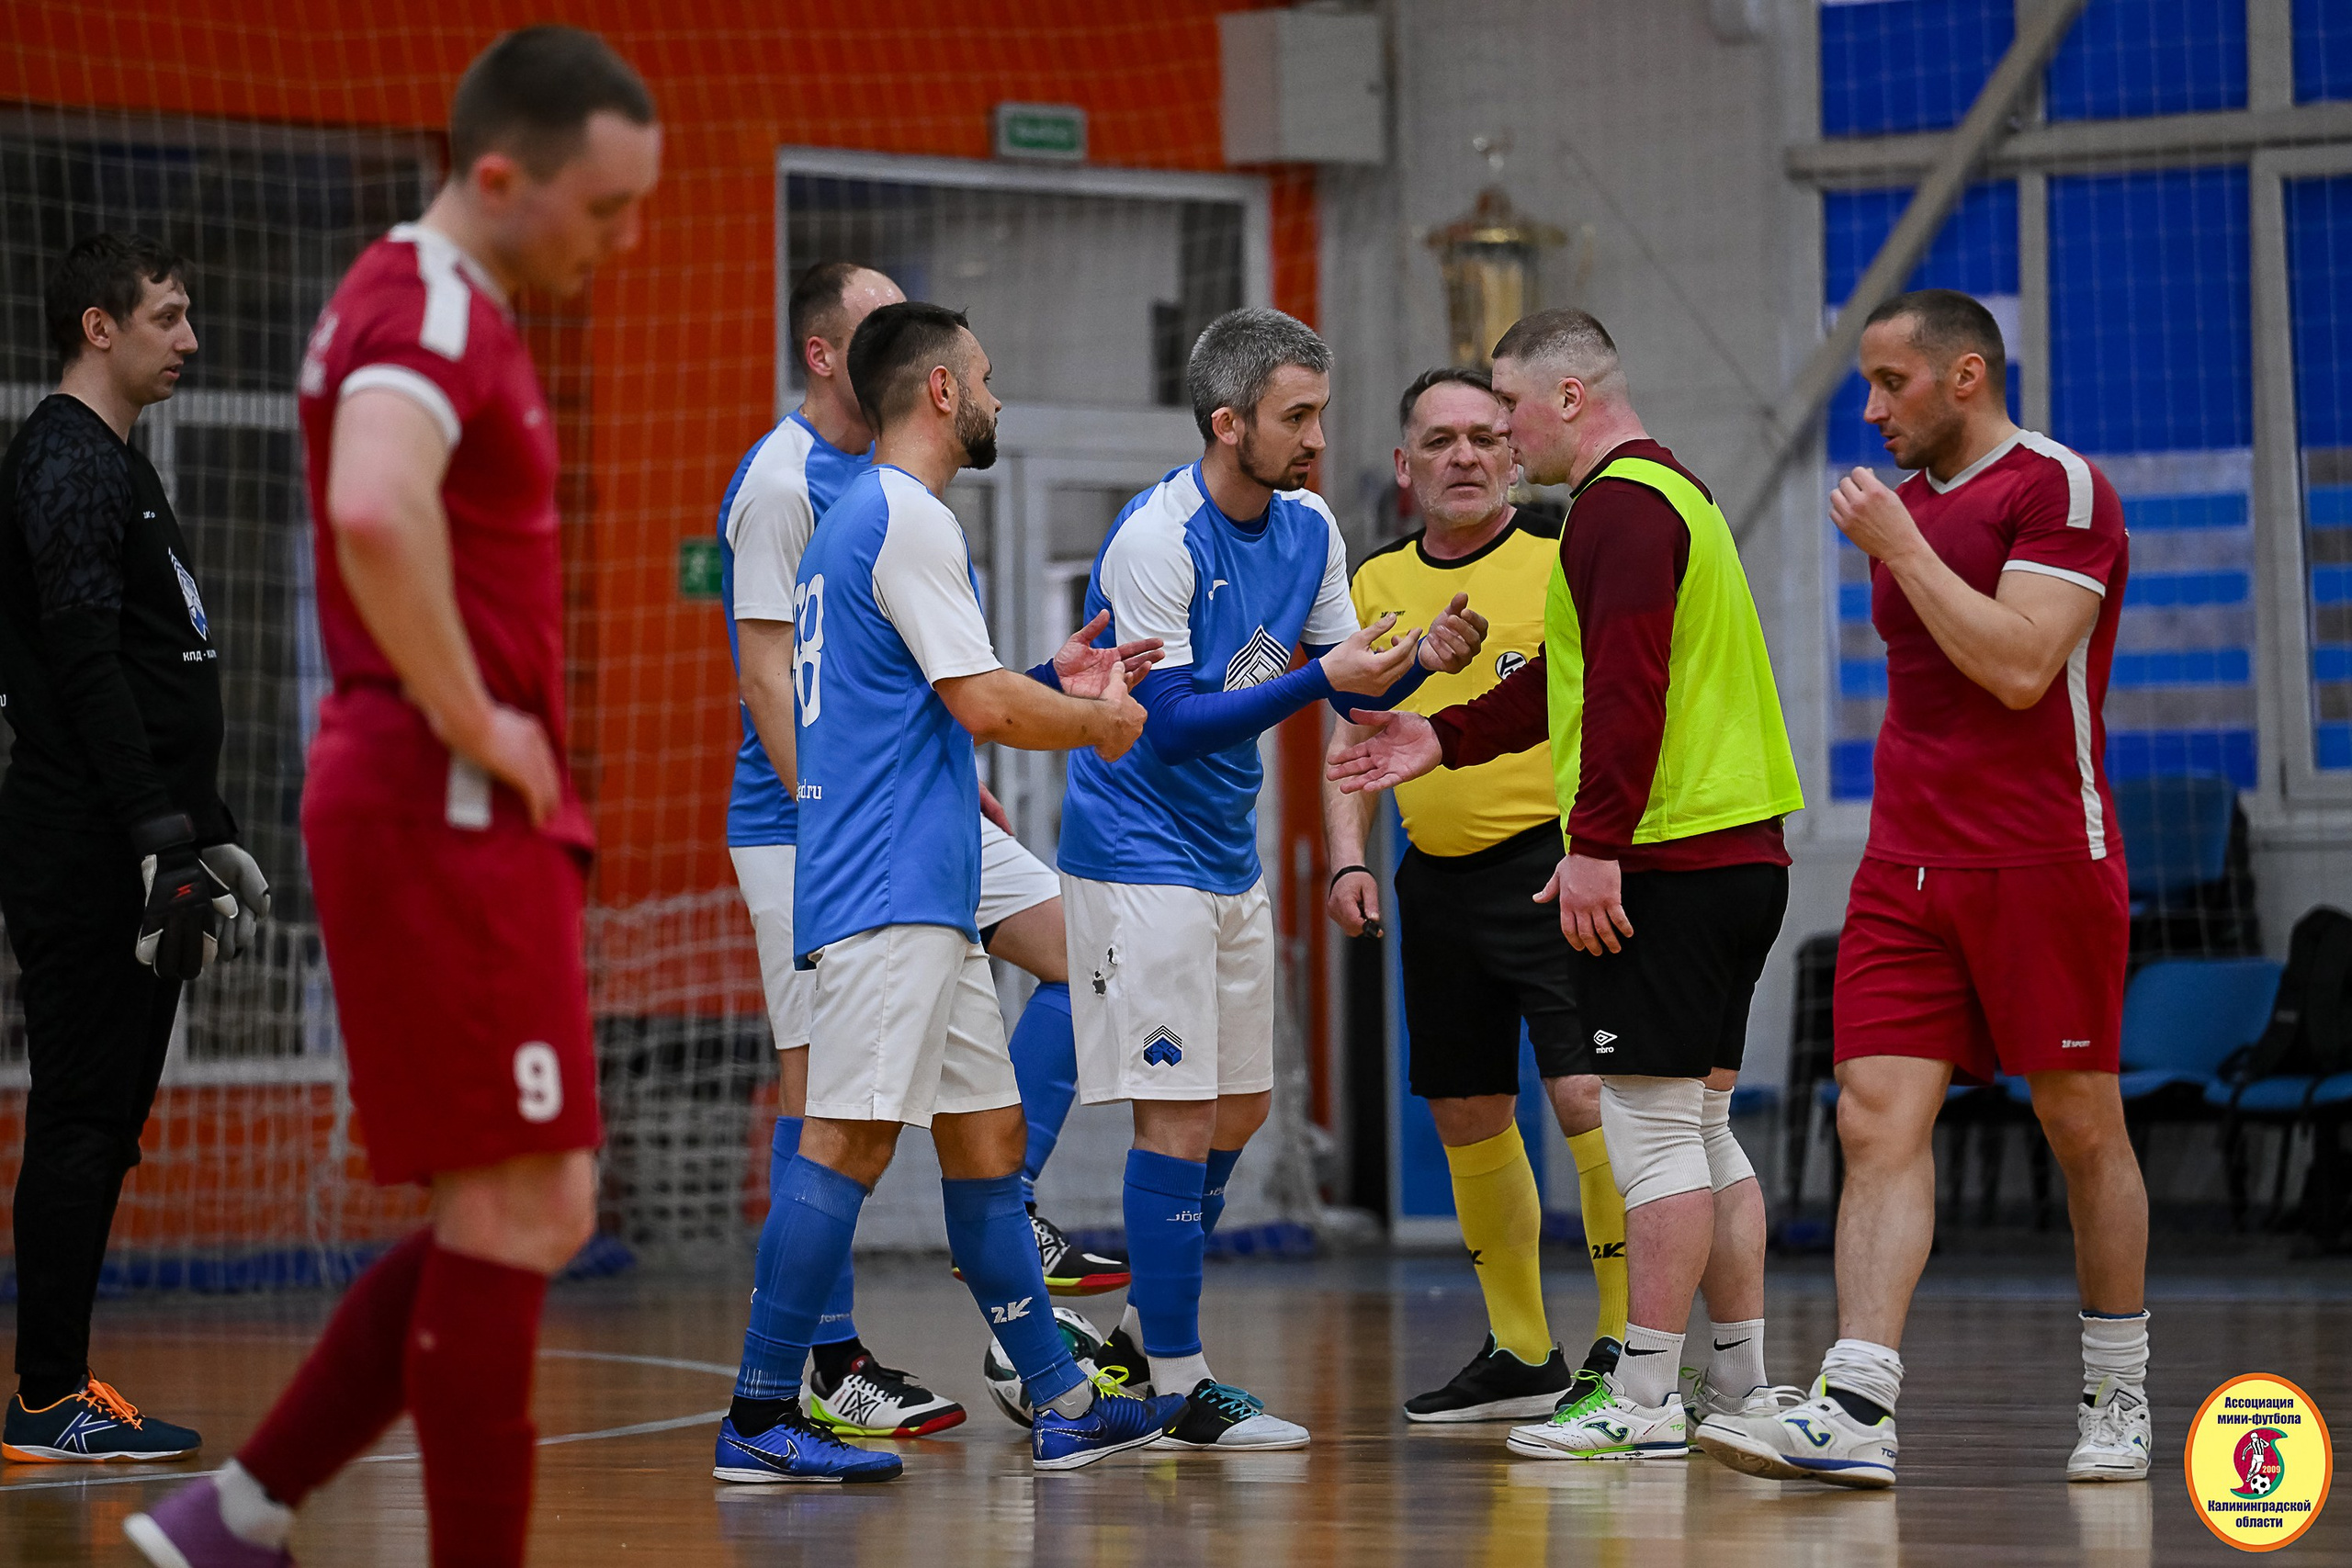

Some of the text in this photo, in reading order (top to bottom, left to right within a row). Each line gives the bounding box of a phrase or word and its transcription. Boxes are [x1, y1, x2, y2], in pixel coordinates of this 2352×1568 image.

[1596, 1045, 1614, 1054] mbro
[514, 1041, 563, 1123] 9
[1592, 1242, 1626, 1259] 2K
[990, 1296, 1033, 1324] 2K
